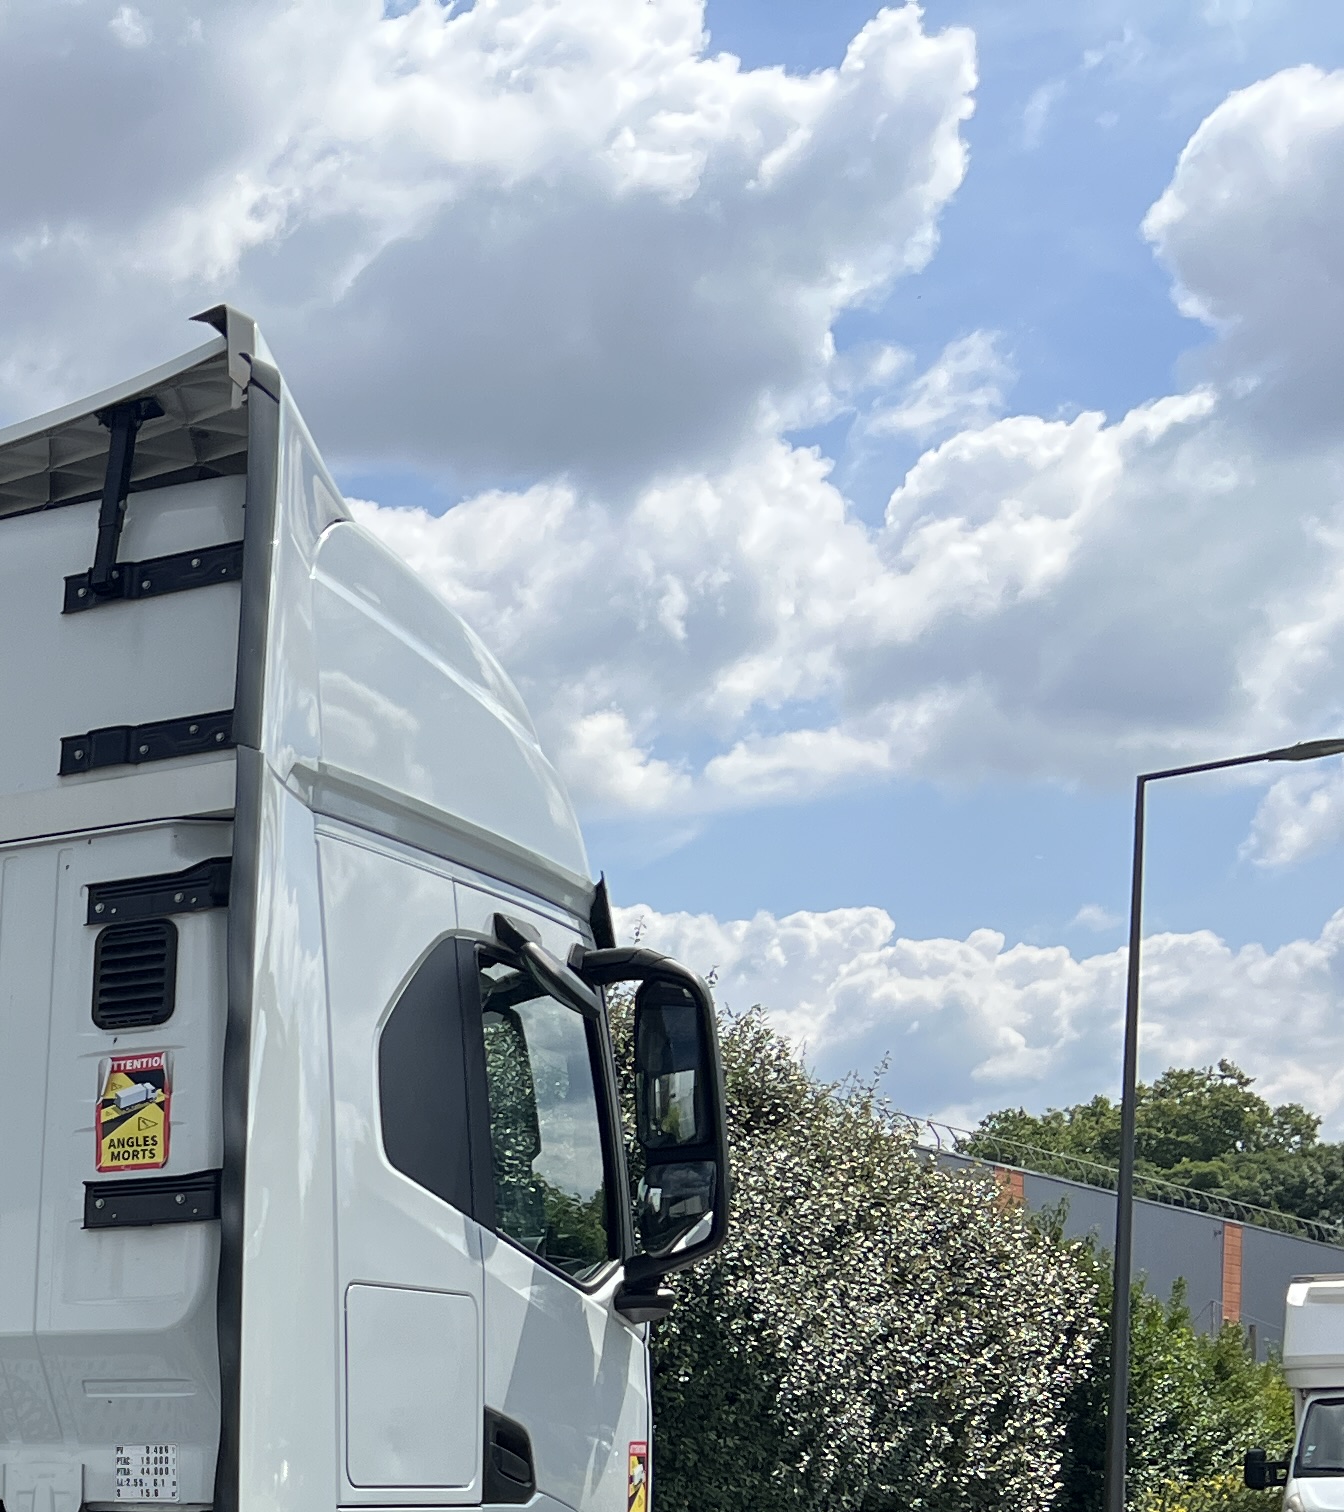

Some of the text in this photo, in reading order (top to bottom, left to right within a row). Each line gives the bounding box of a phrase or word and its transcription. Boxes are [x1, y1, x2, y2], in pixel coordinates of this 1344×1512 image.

[112, 1056, 164, 1071] TTENTIO
[108, 1135, 158, 1150] ANGLES
[110, 1148, 156, 1162] MORTS
